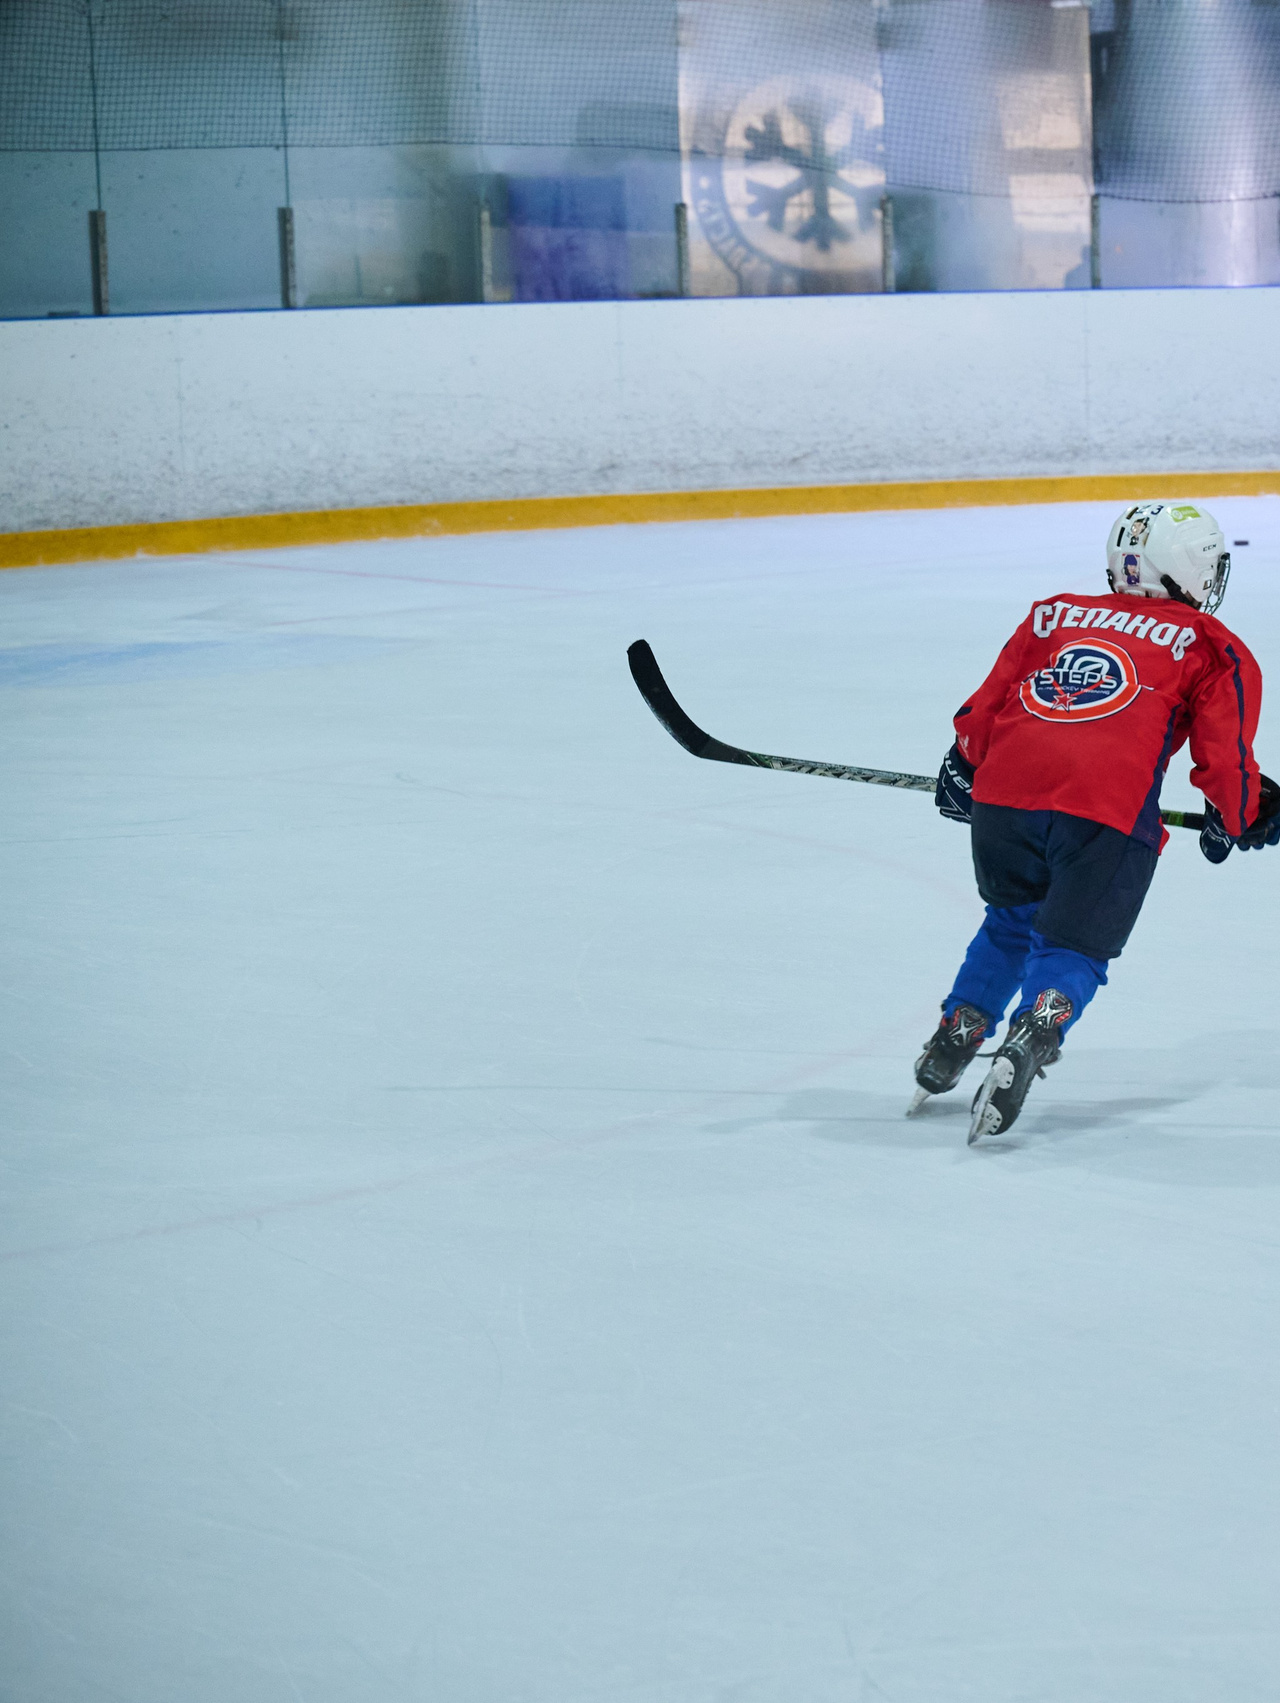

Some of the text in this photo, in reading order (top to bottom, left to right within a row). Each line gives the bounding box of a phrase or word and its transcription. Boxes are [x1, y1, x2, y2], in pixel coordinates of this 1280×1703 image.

[1203, 544, 1217, 552] CCM
[1033, 601, 1197, 661] СТЕПАНОВ
[1063, 653, 1110, 677] 10
[1039, 668, 1118, 689] STEPS
